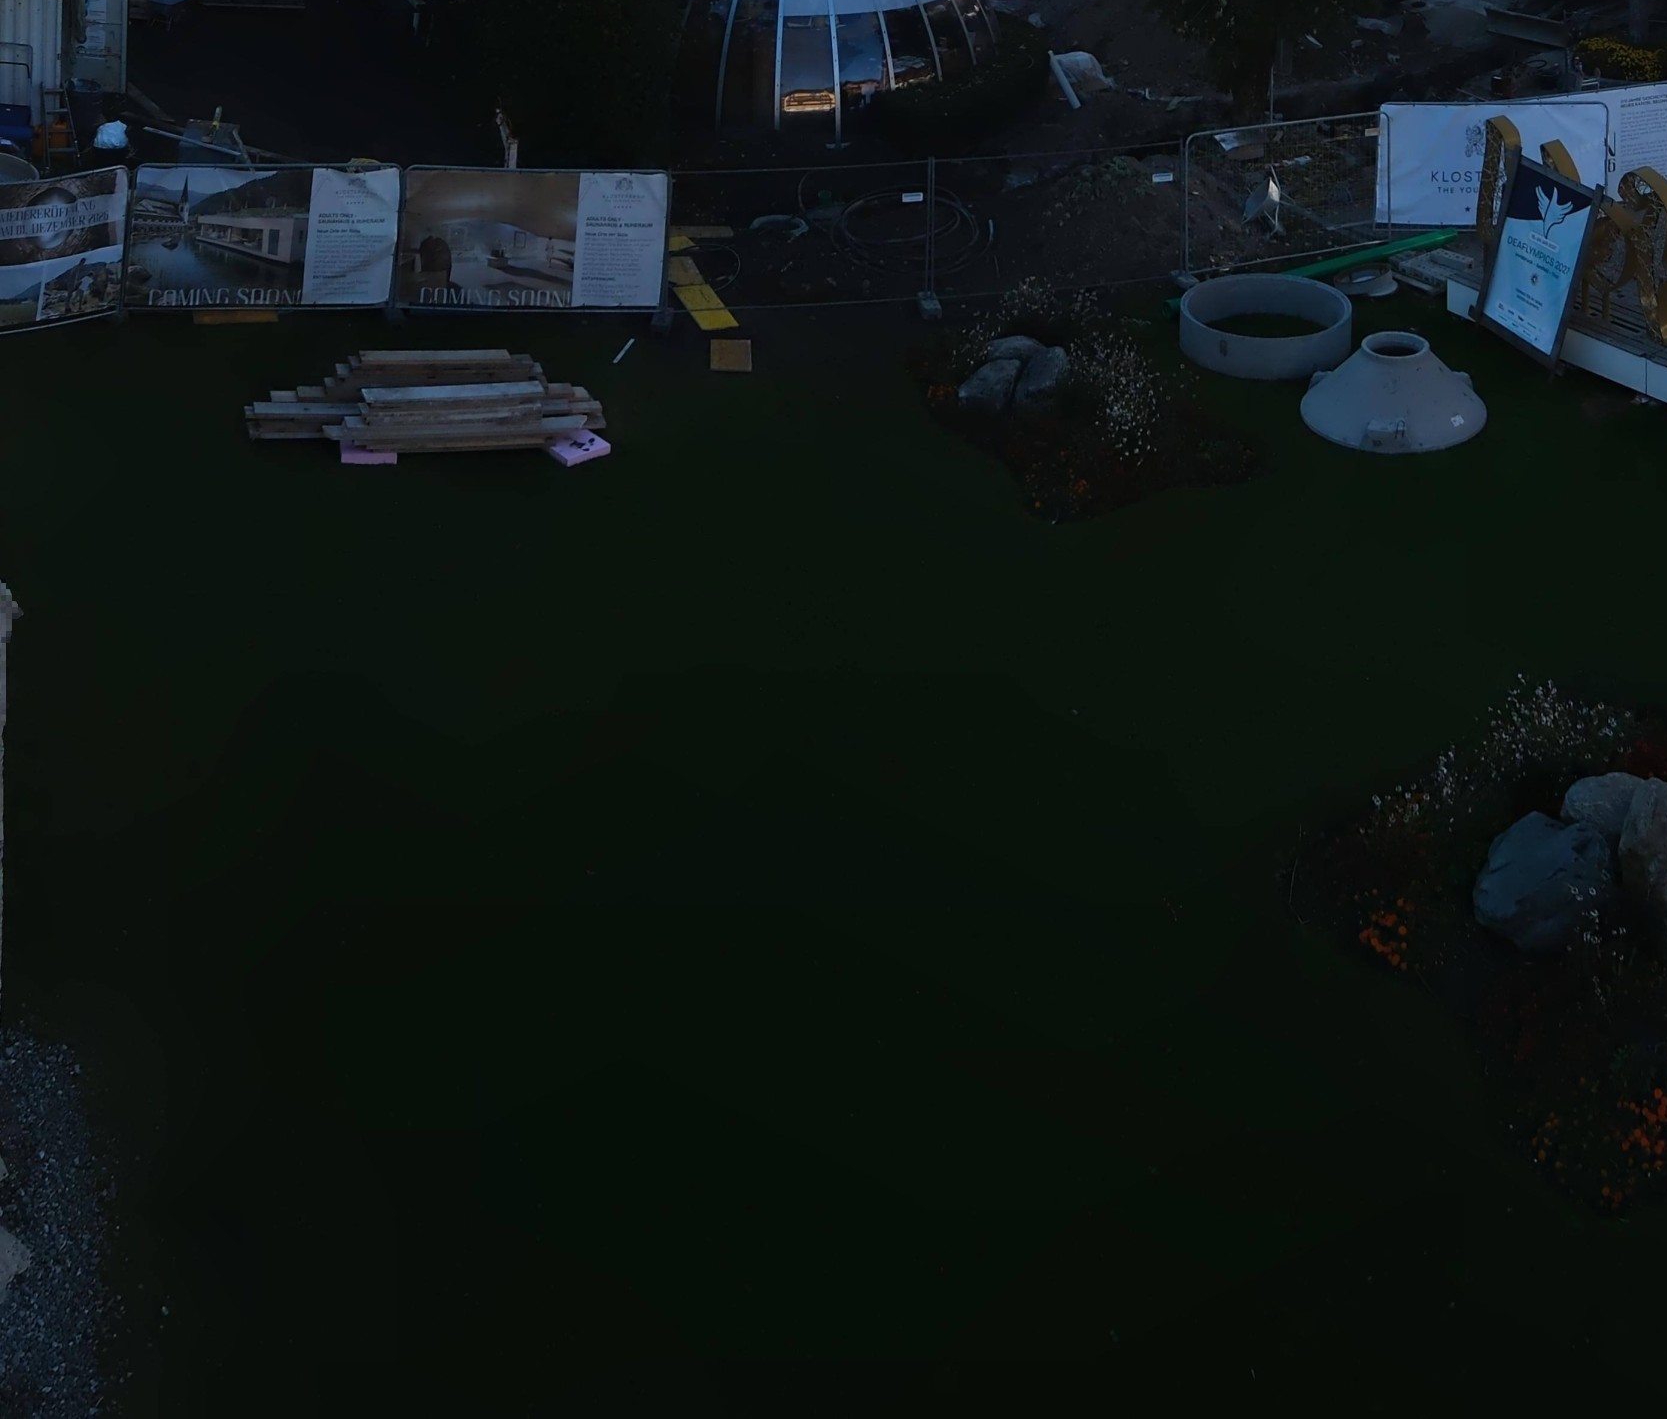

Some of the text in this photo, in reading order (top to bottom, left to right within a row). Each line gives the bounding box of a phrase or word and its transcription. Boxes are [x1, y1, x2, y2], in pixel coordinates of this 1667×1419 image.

[1437, 185, 1460, 195] THE
[1507, 235, 1555, 270] DEAFLYMPICS
[1555, 260, 1570, 275] 2027
[148, 286, 230, 306] COMING
[419, 286, 501, 306] COMING
[507, 288, 571, 308] SOON!
